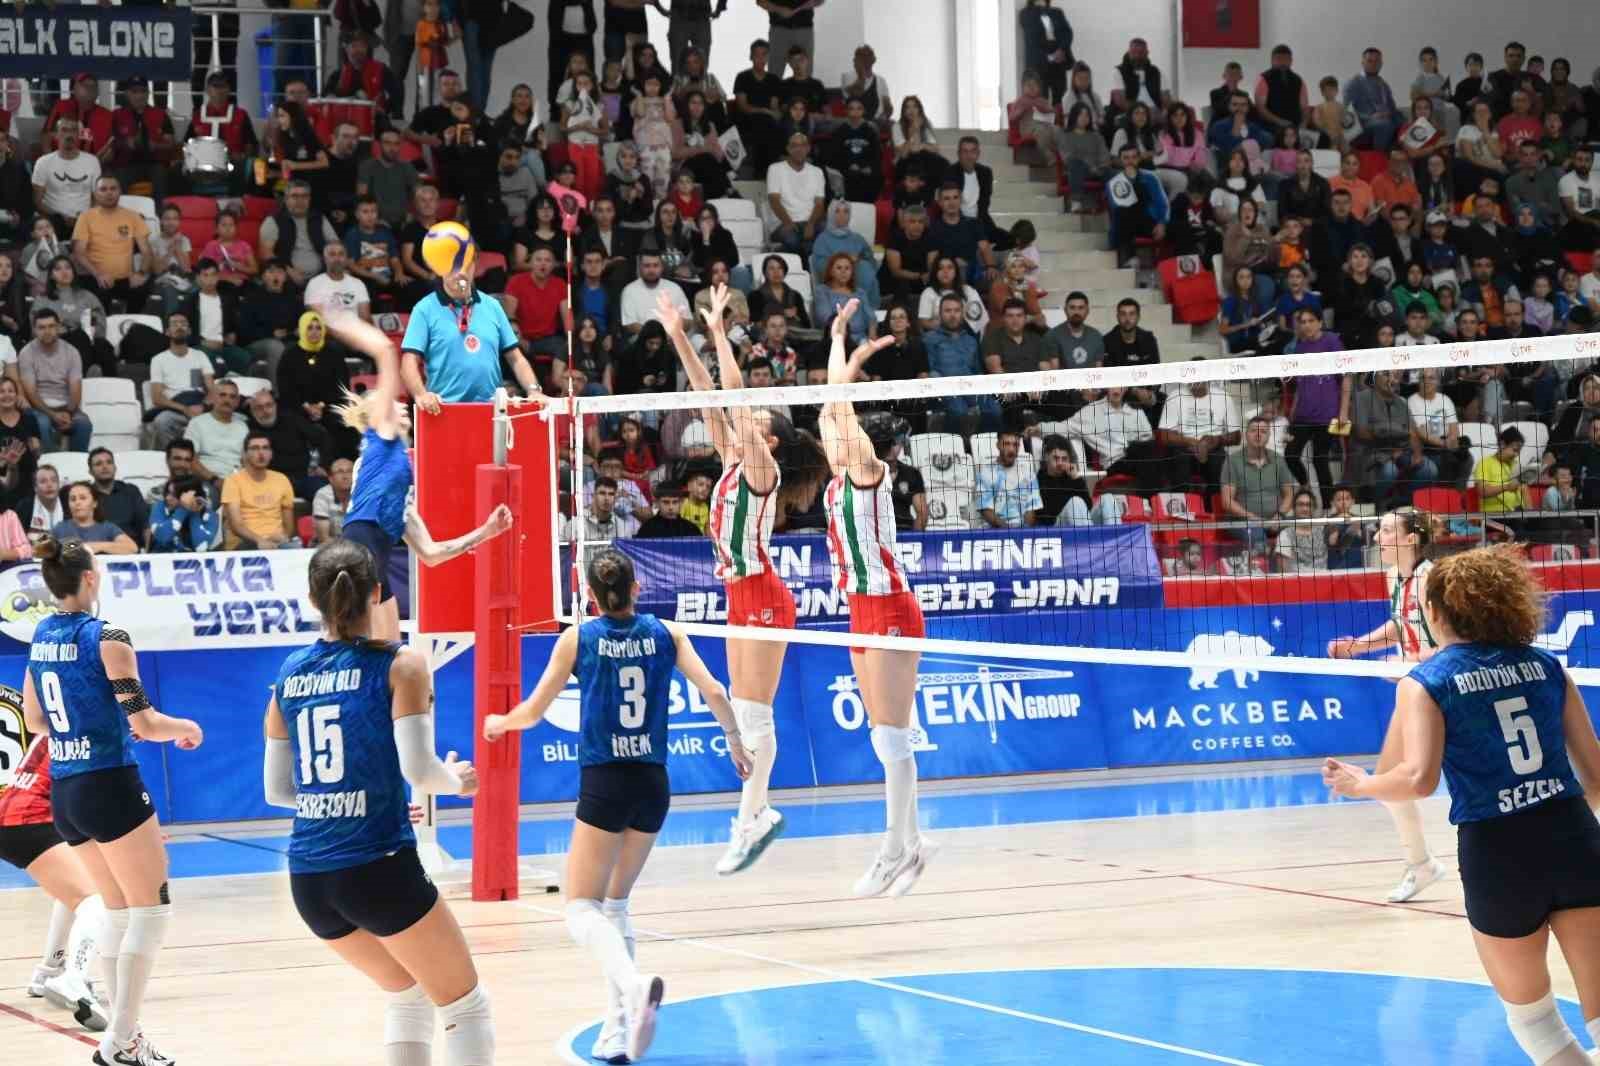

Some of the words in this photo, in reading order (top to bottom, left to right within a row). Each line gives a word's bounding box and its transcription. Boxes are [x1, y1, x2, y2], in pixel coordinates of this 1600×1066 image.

[942, 538, 1062, 571] YANA
[914, 576, 995, 611] BİR
[1011, 577, 1119, 608] YANA
[41, 671, 70, 733] 9
[618, 666, 646, 729] 3
[1024, 694, 1081, 720] GROUP
[1132, 698, 1344, 730] MACKBEAR
[297, 704, 344, 785] 15
[1192, 735, 1265, 751] COFFEE
[1271, 734, 1296, 747] CO.
[1494, 696, 1543, 775] 5
[141, 791, 150, 805] 9
